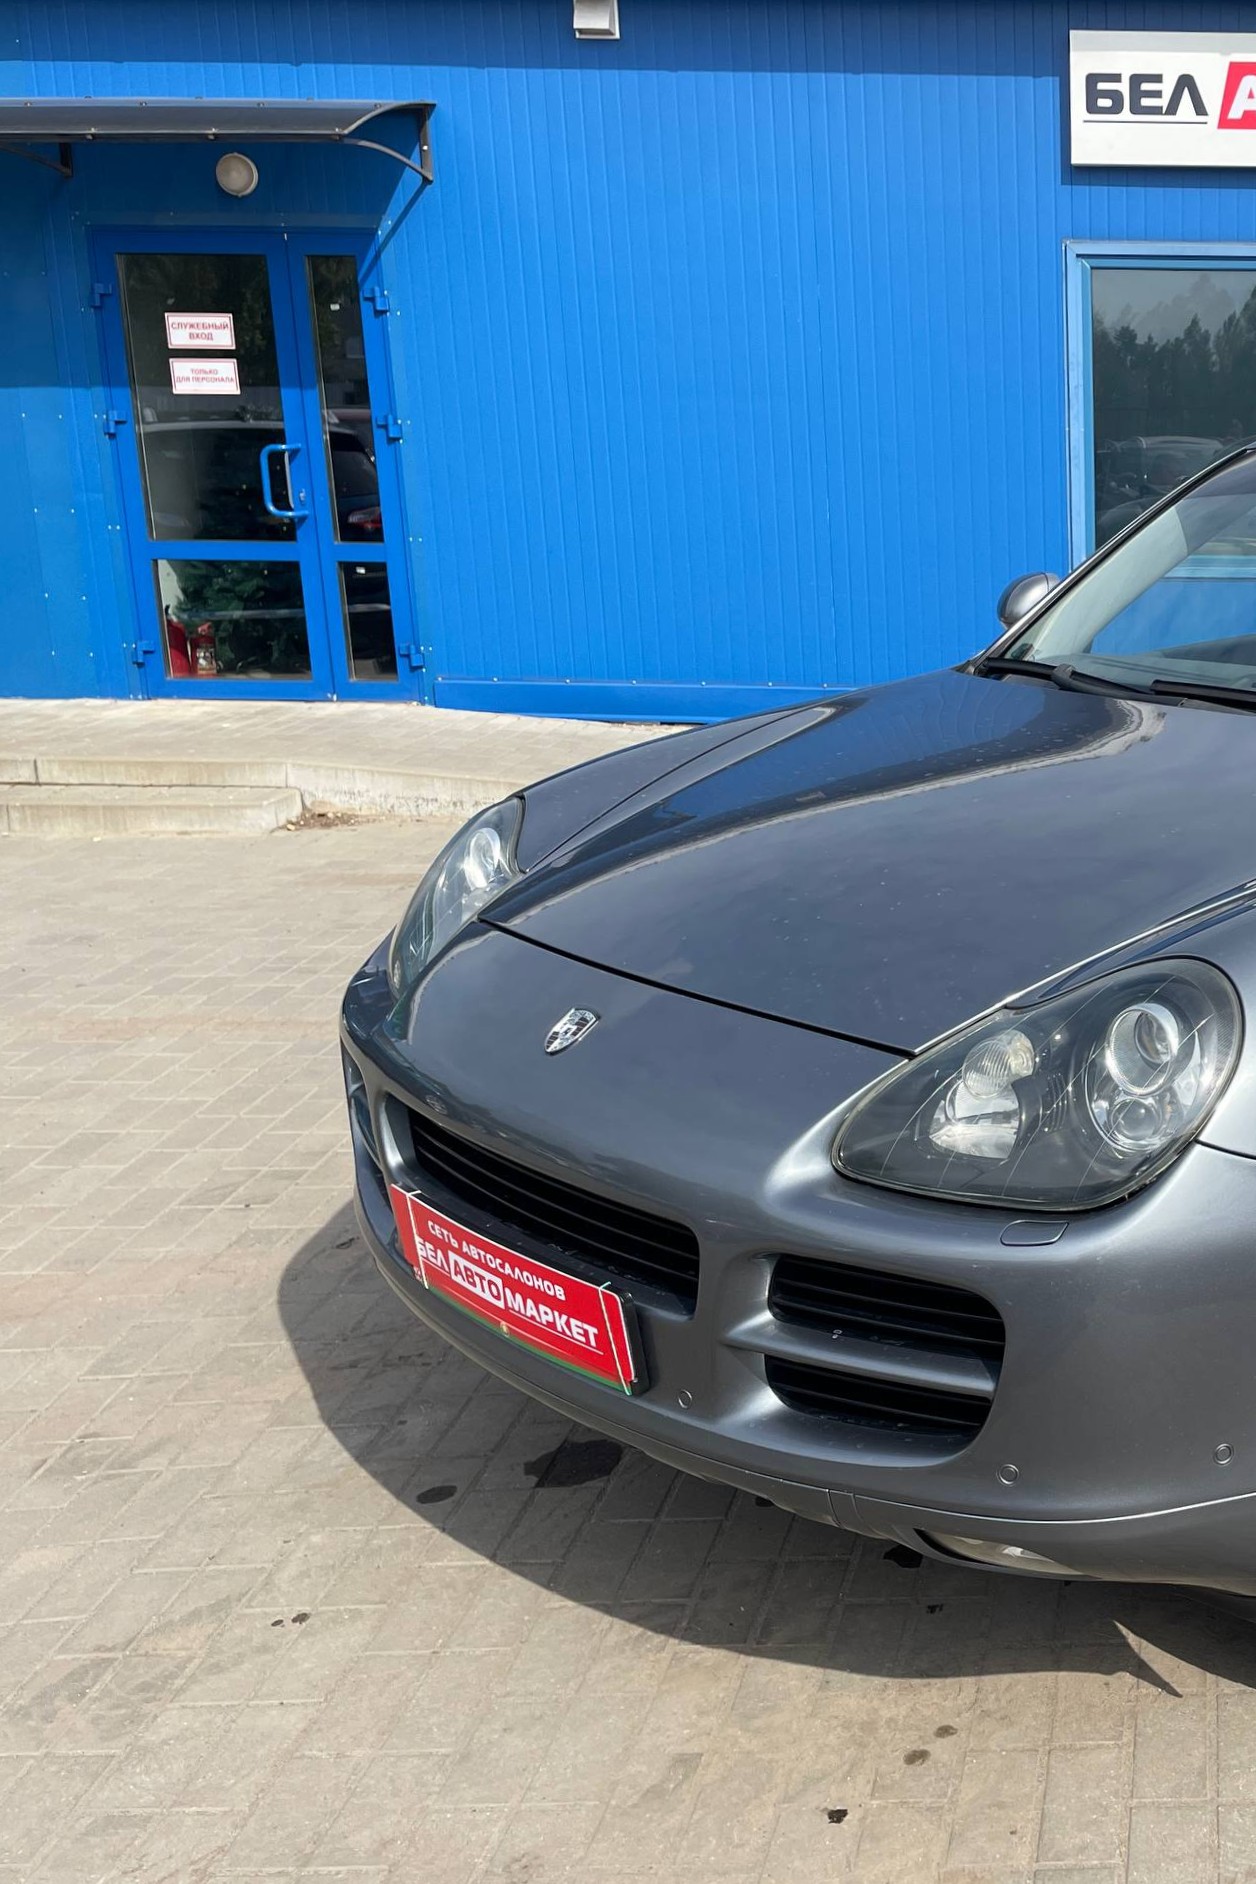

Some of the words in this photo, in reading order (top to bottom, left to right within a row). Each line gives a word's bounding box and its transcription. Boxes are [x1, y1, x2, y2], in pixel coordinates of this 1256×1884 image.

[1085, 73, 1208, 116] БЕЛ
[171, 321, 228, 330] СЛУЖЕБНЫЙ
[189, 332, 214, 341] ВХОД
[428, 1220, 459, 1247] СЕТЬ
[462, 1241, 566, 1301] АВТОСАЛОНОВ
[417, 1237, 449, 1272] БЕЛ
[453, 1260, 501, 1300] АВТО
[503, 1287, 598, 1347] МАРКЕТ
